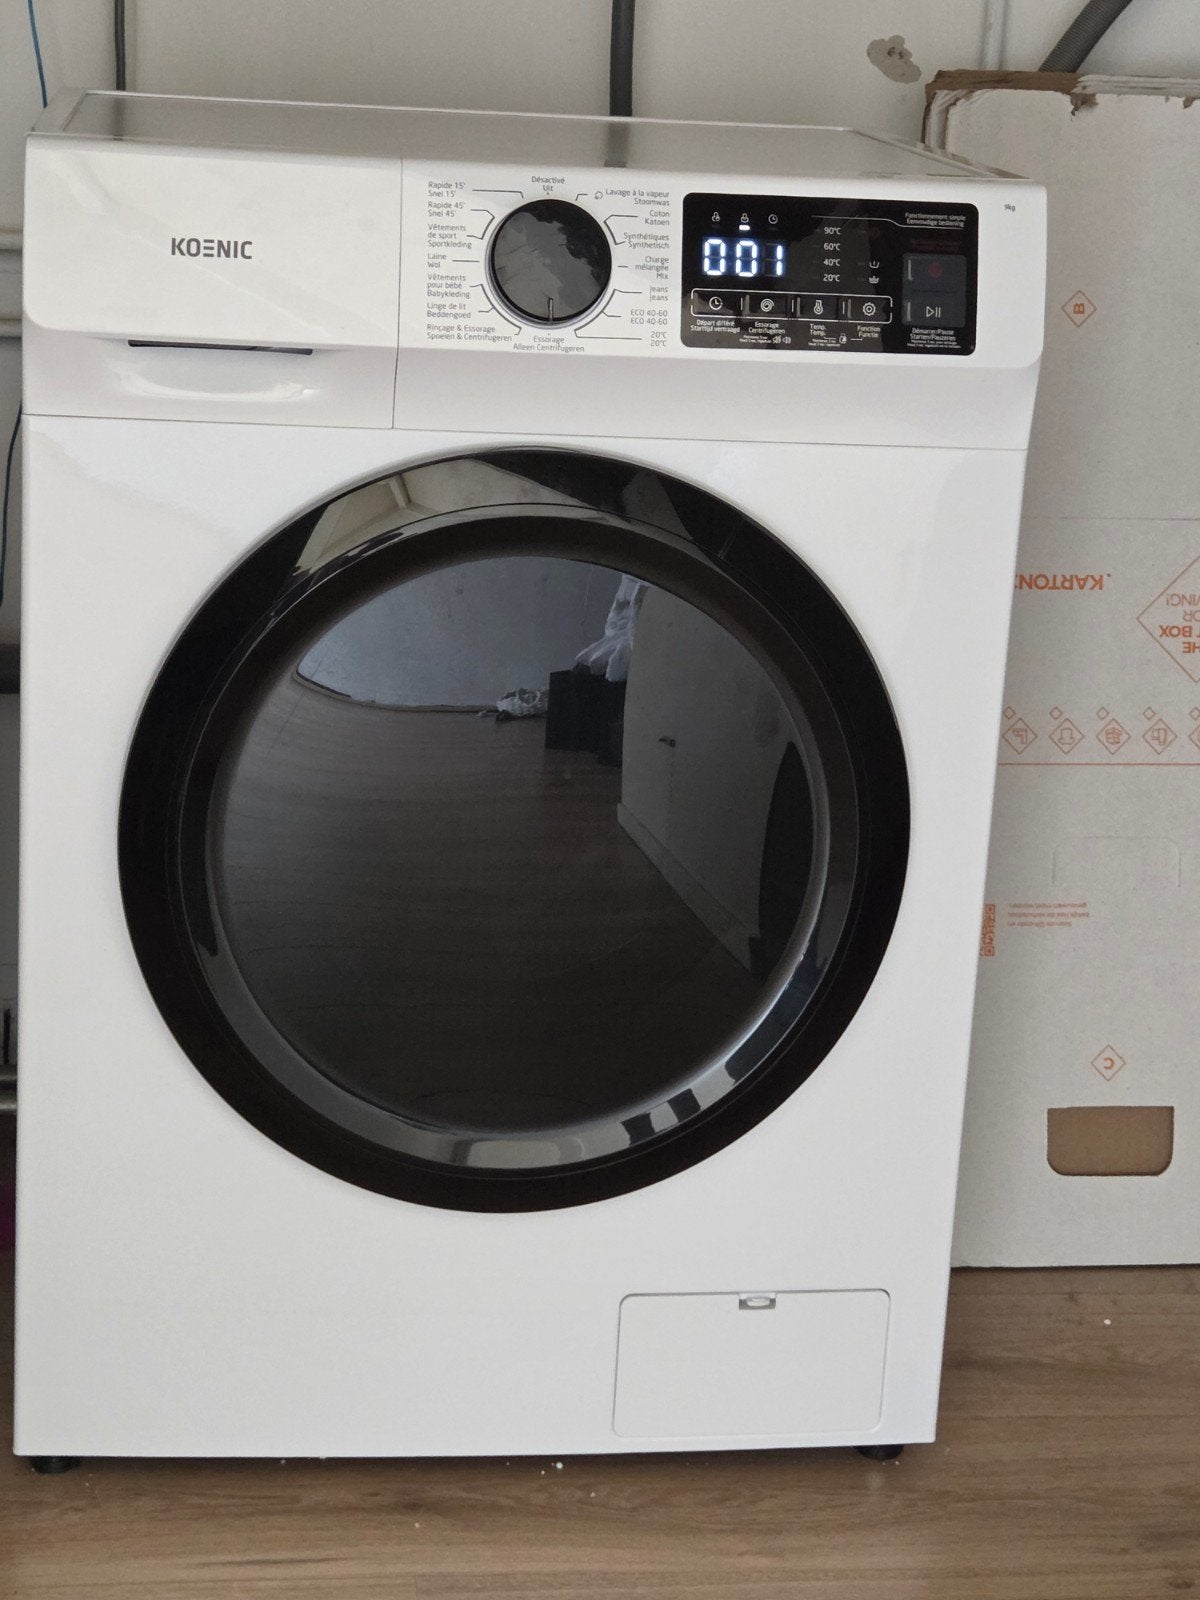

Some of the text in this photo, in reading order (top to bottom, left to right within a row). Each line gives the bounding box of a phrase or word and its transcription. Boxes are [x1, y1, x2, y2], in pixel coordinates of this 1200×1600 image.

[531, 176, 565, 184] Désactivé
[428, 181, 452, 190] Rapide
[606, 188, 630, 197] Lavage
[428, 201, 452, 209] Rapide
[634, 198, 670, 206] Stoomwas
[1004, 204, 1016, 212] 9kg
[645, 218, 670, 226] Katoen
[428, 223, 467, 231] Vêtements
[823, 227, 841, 235] 90°C
[438, 232, 456, 240] sport
[623, 232, 669, 241] Synthétiques
[171, 238, 252, 259] KOENIC
[428, 240, 472, 249] Sportkleding
[629, 240, 669, 250] Synthetisch
[823, 243, 841, 251] 60°C
[645, 256, 669, 265] Charge
[703, 238, 783, 277] 001
[635, 264, 669, 272] mélangée
[427, 273, 466, 281] Vêtements
[823, 274, 840, 282] 20°C
[650, 285, 669, 293] Jeans
[427, 290, 471, 299] Babykleding
[649, 294, 669, 302] Jeans
[427, 303, 447, 311] Linge
[1073, 303, 1085, 314] B
[427, 311, 471, 319] Beddengoed
[427, 324, 455, 333] Rinçage
[464, 325, 496, 334] Essorage
[427, 333, 455, 341] Spoelen
[464, 334, 512, 343] Centrifugeren
[650, 331, 667, 339] 20°C
[533, 336, 565, 344] Essorage
[513, 343, 585, 353] Alleen Centrifugeren
[1015, 574, 1104, 591] KARTON
[1159, 625, 1192, 637] BOX
[1104, 1057, 1115, 1070] C
